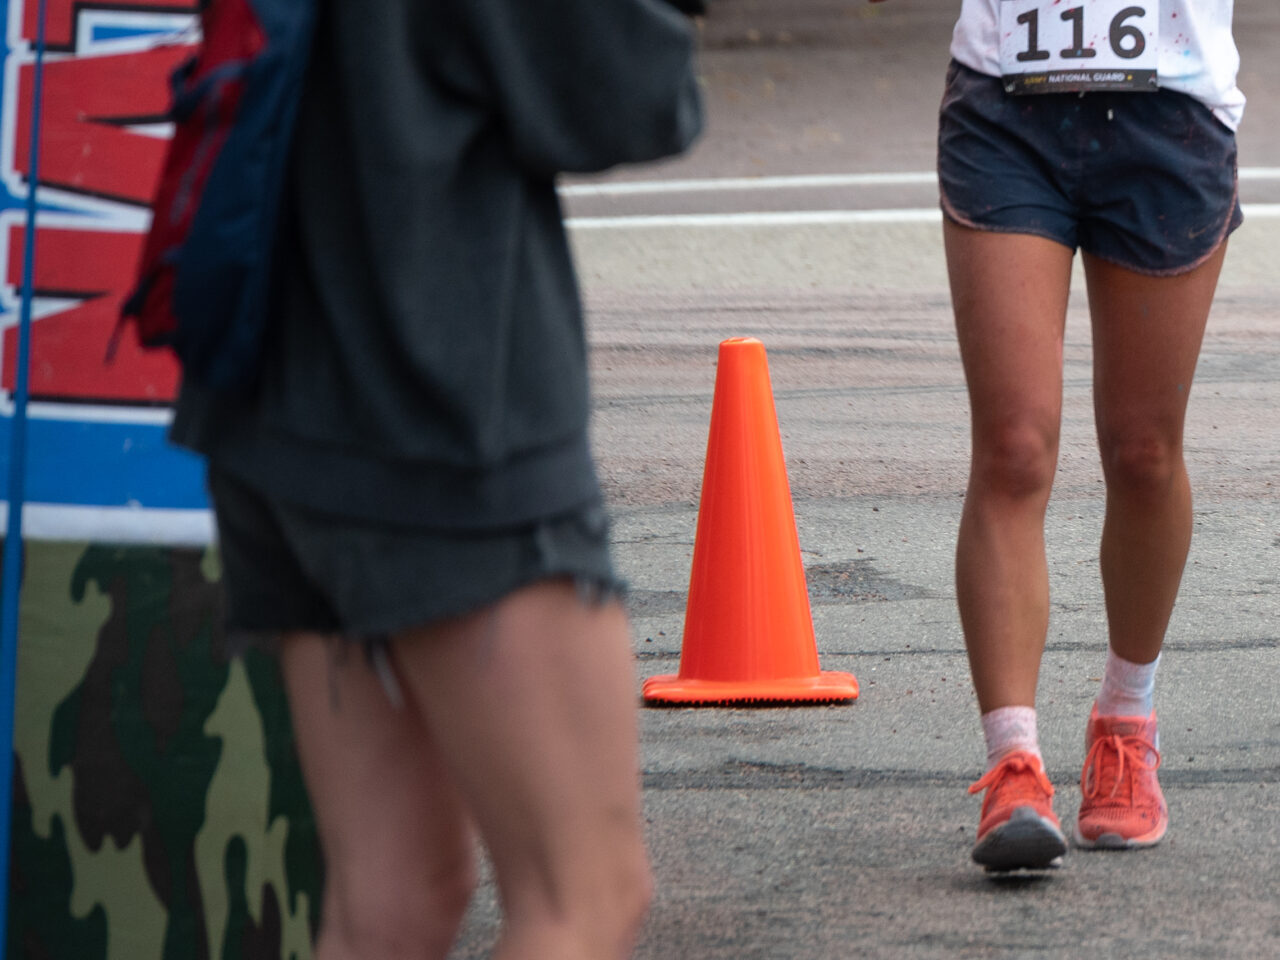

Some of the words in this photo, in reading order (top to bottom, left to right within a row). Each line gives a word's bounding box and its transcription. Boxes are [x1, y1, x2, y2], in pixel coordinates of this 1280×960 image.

[1016, 6, 1146, 62] 116
[1048, 74, 1091, 84] NATIONAL
[1093, 72, 1126, 83] GUARD
